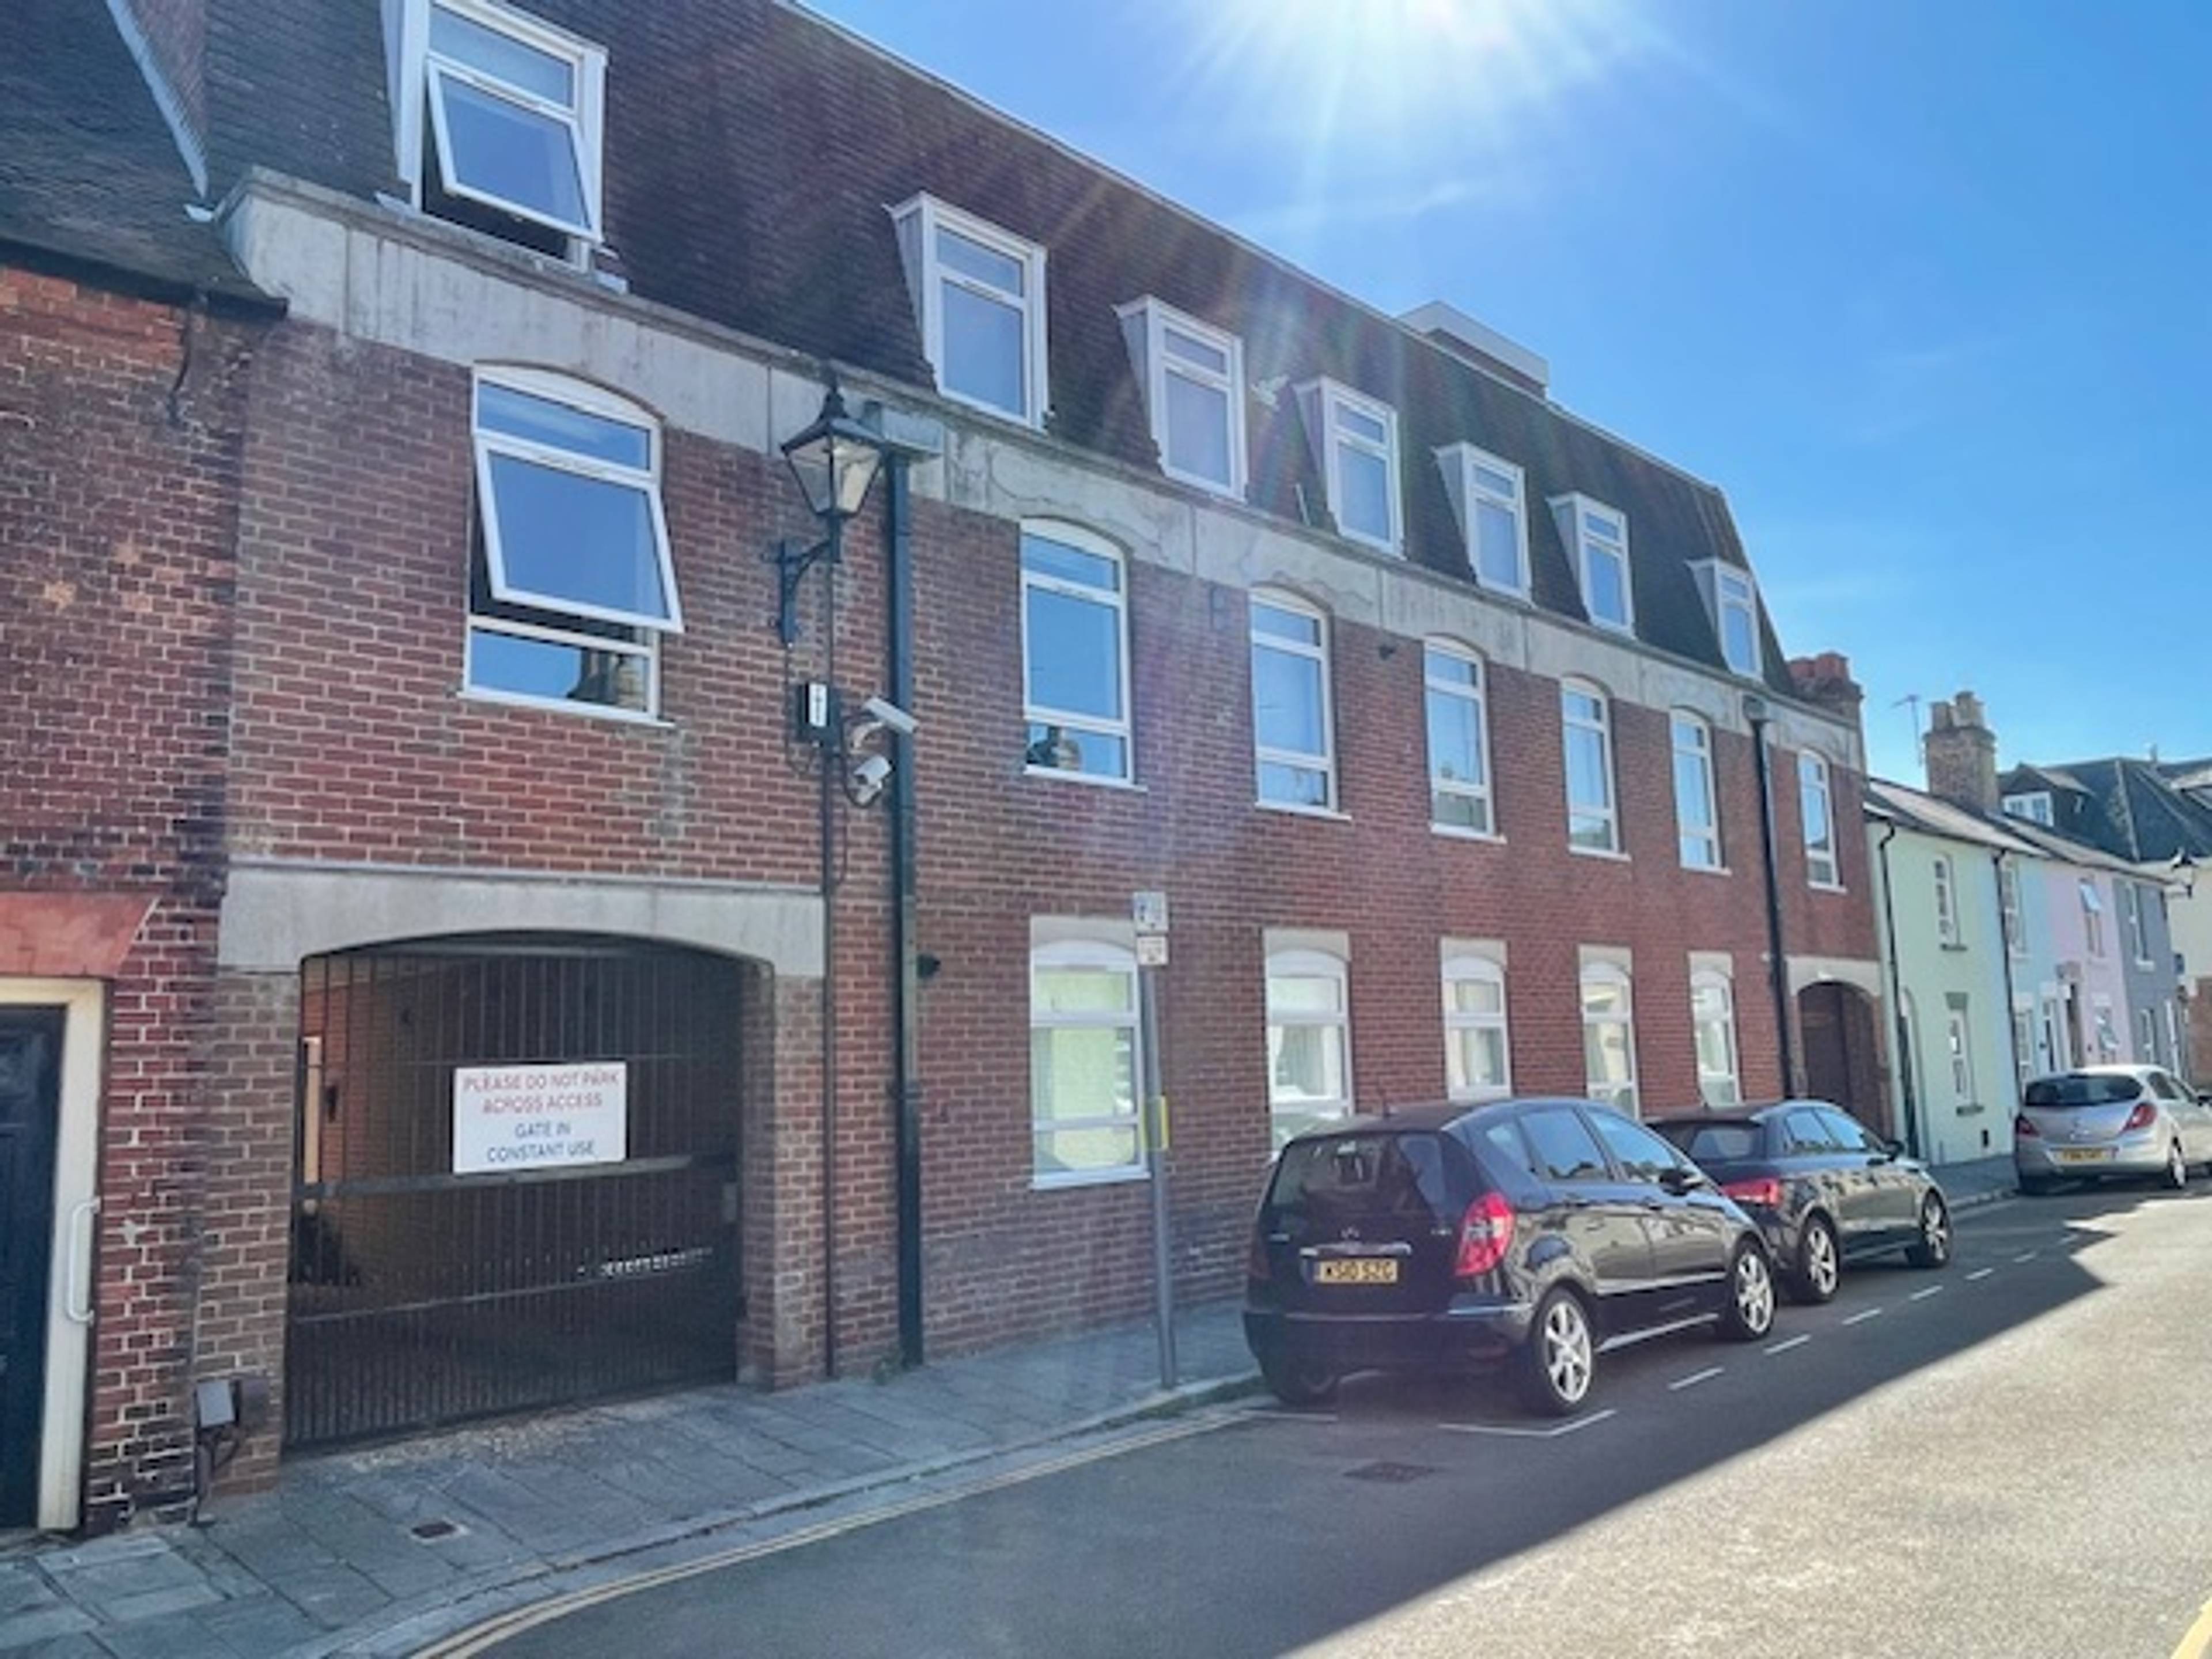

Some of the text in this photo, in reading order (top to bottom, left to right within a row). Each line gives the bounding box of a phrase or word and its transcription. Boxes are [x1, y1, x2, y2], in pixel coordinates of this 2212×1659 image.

[464, 1070, 619, 1092] PLEASE DO NOT PARK
[483, 1093, 602, 1113] ACROSS ACCESS
[515, 1121, 571, 1139] GATE IN
[487, 1140, 594, 1162] CONSTANT USE
